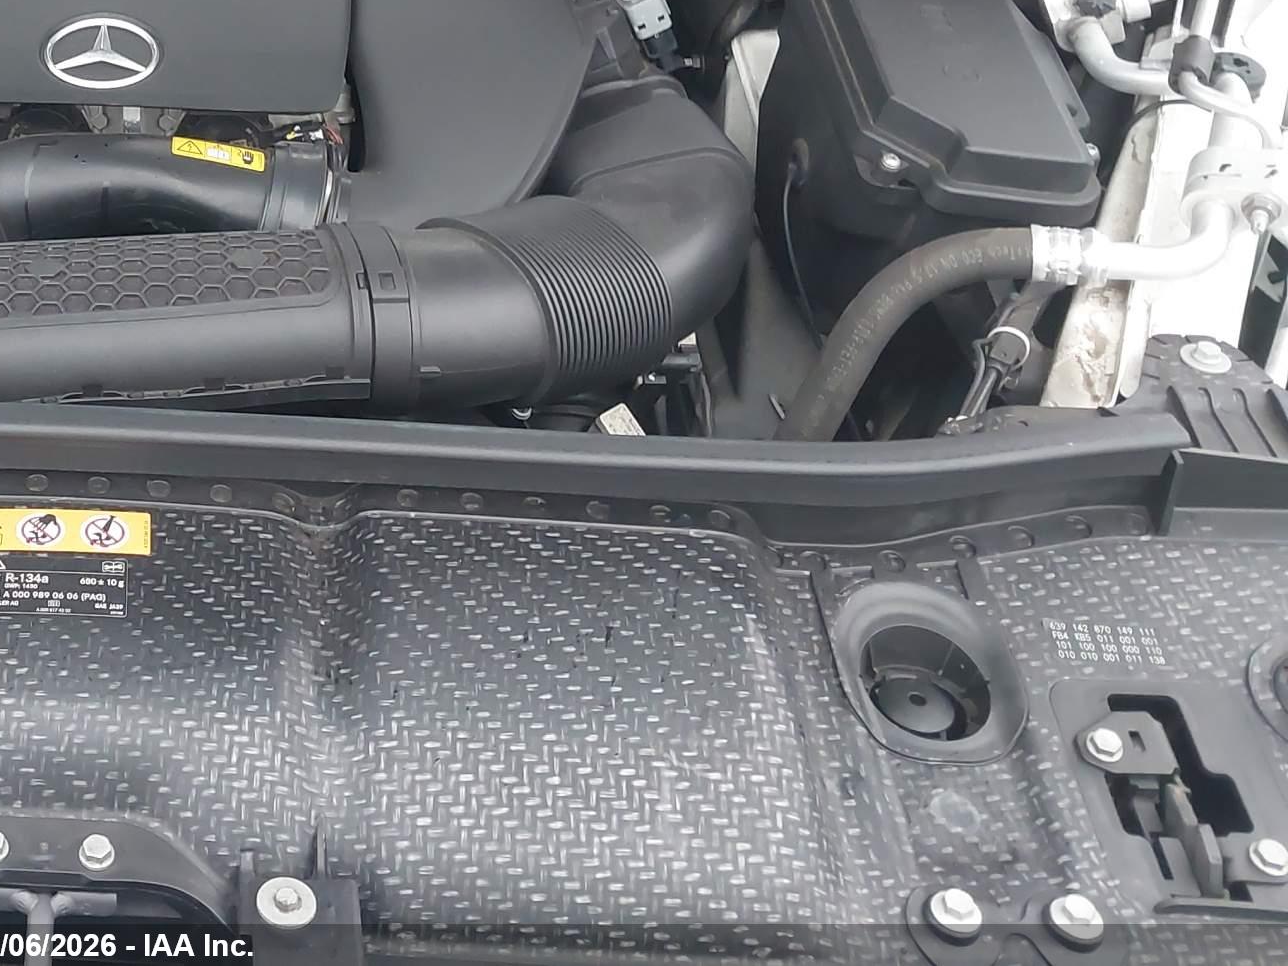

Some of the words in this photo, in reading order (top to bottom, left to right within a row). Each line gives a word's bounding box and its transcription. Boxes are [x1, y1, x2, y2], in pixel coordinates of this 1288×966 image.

[5, 572, 49, 584] R-134a
[52, 591, 64, 599] 06
[66, 592, 79, 600] 06
[81, 592, 106, 602] (PAG)
[1096, 634, 1114, 643] 011
[1119, 635, 1136, 644] 001
[1056, 640, 1072, 650] 101
[1079, 642, 1095, 651] 100
[1101, 643, 1118, 653] 100
[1122, 644, 1140, 654] 000
[1145, 646, 1162, 655] 110
[1058, 649, 1076, 659] 010
[1080, 651, 1098, 661] 010
[1103, 652, 1120, 663] 001
[1125, 654, 1142, 664] 011
